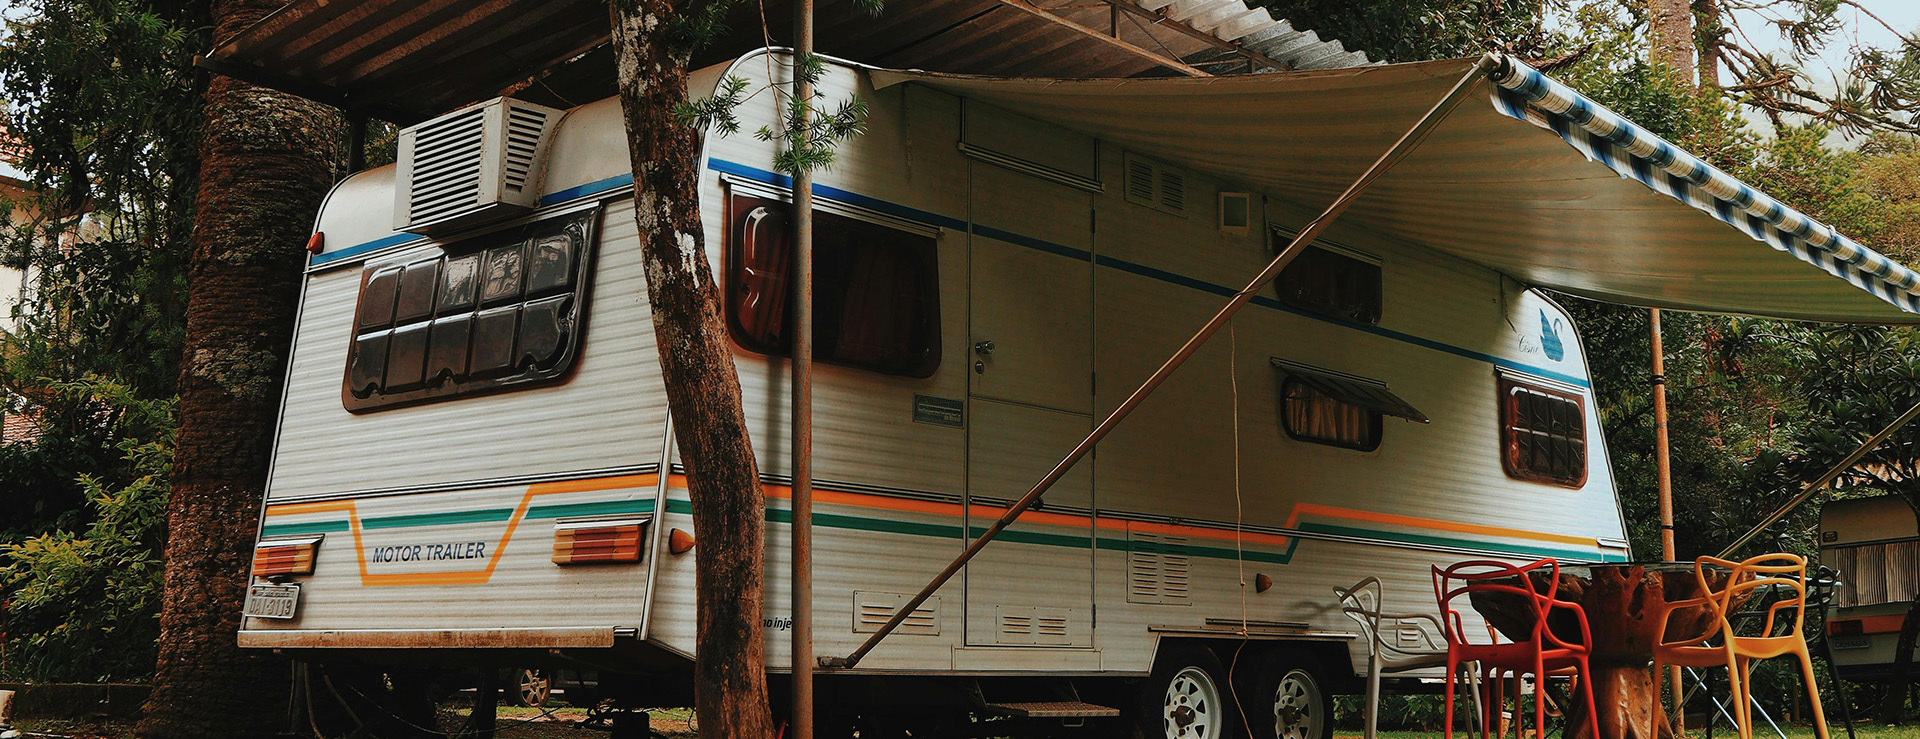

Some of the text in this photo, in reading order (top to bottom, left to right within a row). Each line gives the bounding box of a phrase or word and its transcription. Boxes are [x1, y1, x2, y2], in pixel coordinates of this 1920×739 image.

[373, 541, 485, 563] MOTOR TRAILER
[774, 616, 793, 631] inje
